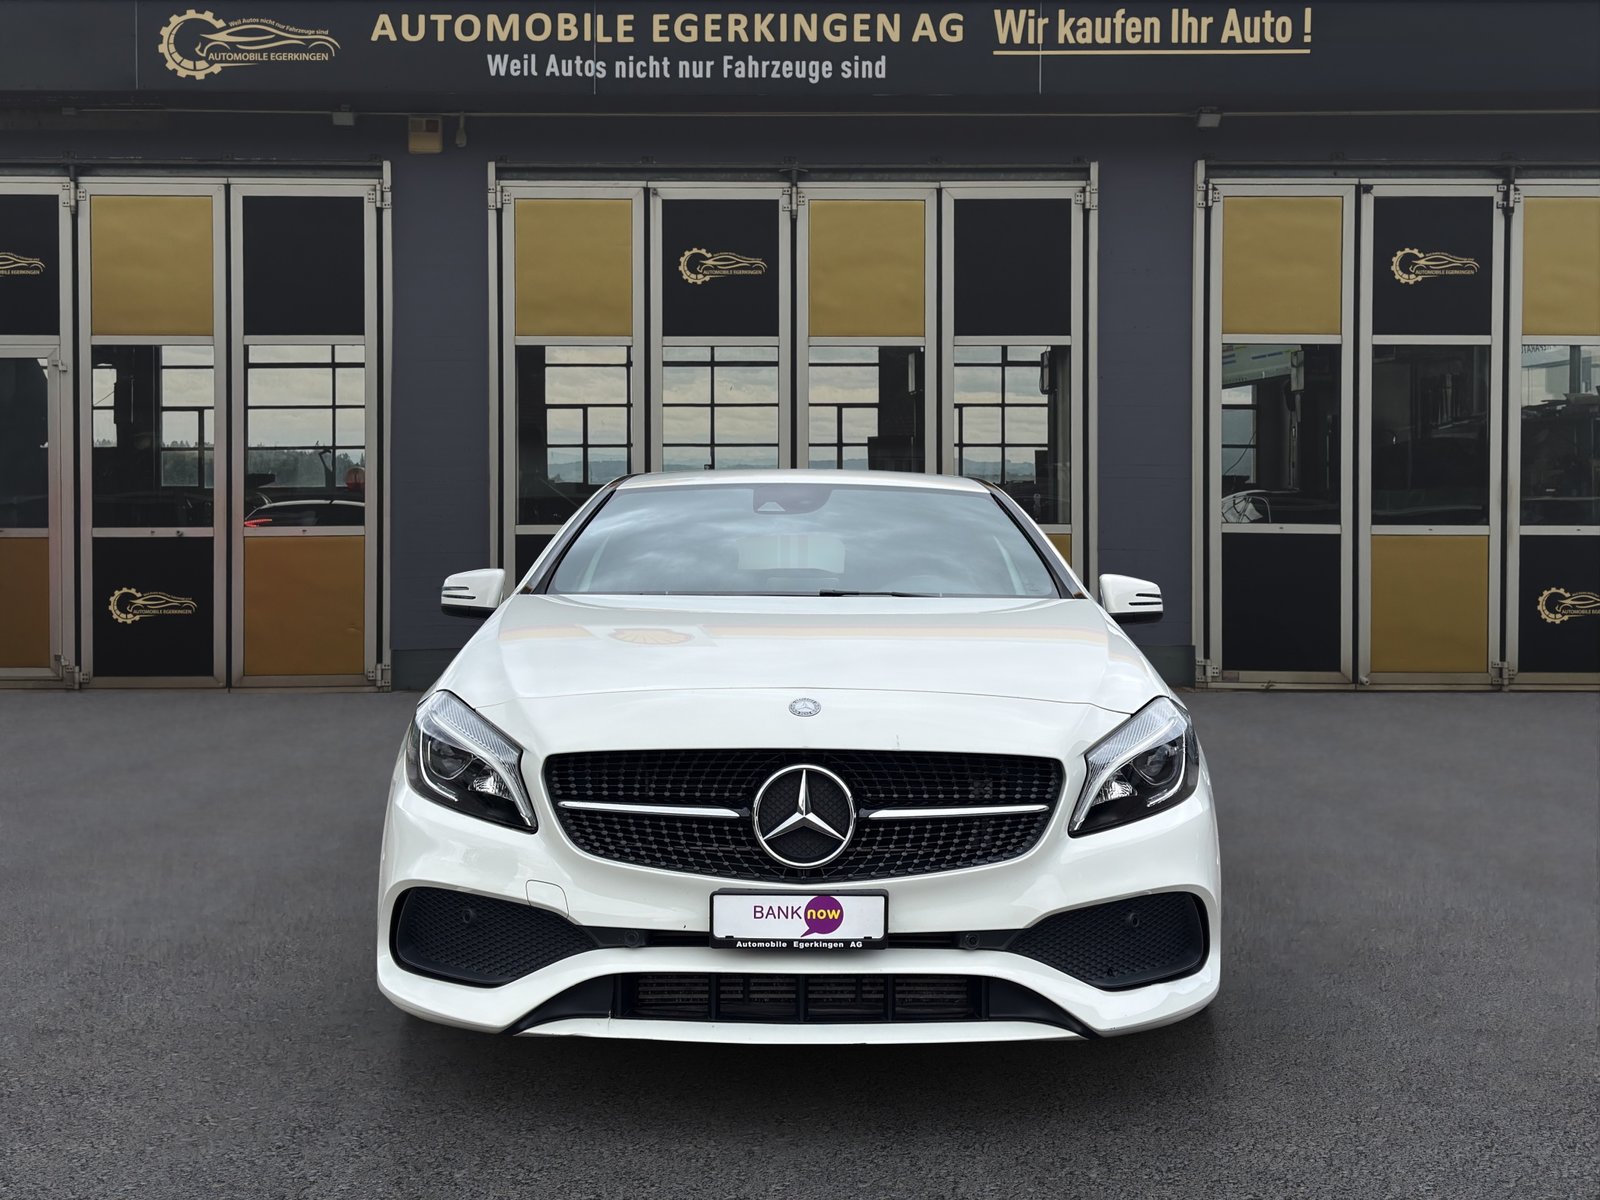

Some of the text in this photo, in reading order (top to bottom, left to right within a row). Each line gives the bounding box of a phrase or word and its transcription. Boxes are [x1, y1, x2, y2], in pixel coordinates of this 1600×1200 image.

[228, 18, 242, 28] Weil
[260, 17, 275, 27] nicht
[275, 22, 286, 30] nur
[286, 25, 315, 35] Fahrzeuge
[370, 12, 965, 43] AUTOMOBILE EGERKINGEN AG
[993, 7, 1312, 45] Wir kaufen Ihr Auto !
[208, 52, 329, 61] AUTOMOBILE EGERKINGEN
[486, 53, 887, 84] Weil Autos nicht nur Fahrzeuge sind
[753, 905, 841, 920] BANK now
[736, 940, 787, 948] Automobile
[793, 940, 844, 949] Egerkingen
